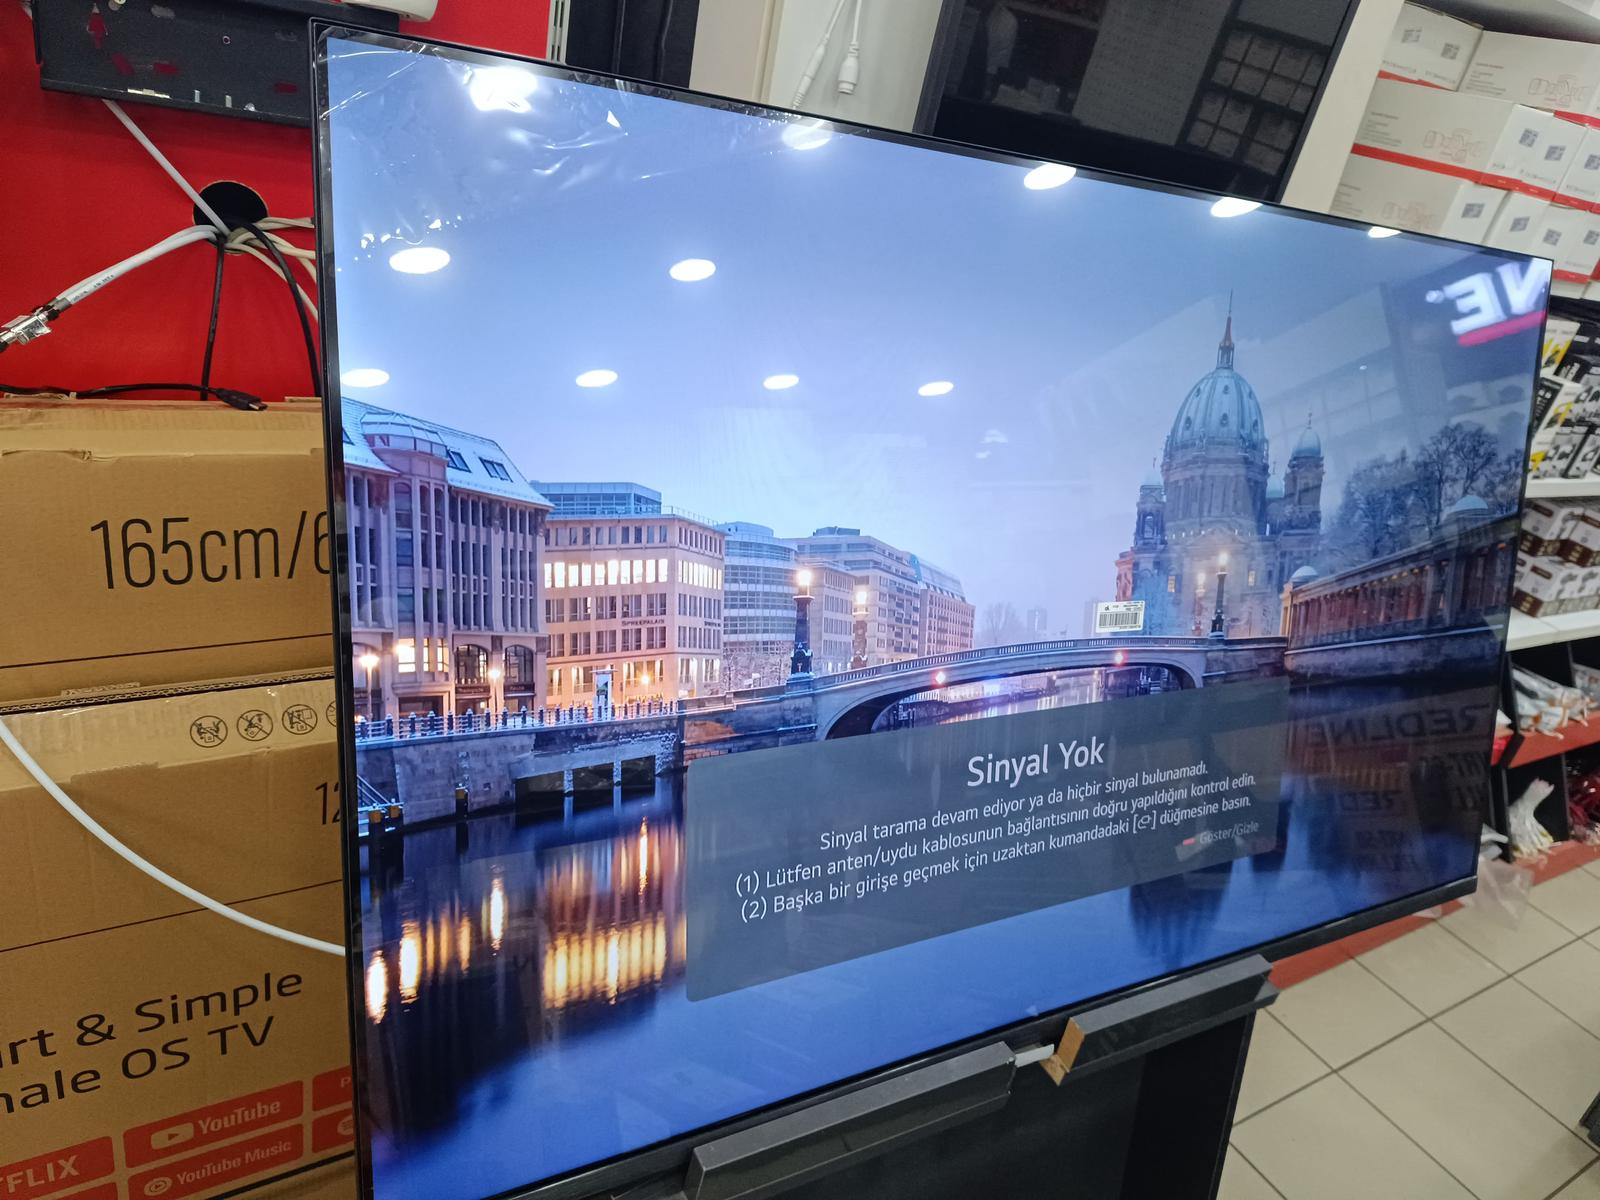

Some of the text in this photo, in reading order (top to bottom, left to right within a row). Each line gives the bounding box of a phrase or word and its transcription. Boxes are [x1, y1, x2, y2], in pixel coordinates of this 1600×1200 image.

[967, 736, 1105, 788] Sinyal Yok
[735, 772, 1257, 898] (1) Lütfen anten/uydu kablosunun bağlantısının doğru yapıldığını kontrol edin.
[820, 760, 1209, 850] Sinyal tarama devam ediyor ya da hiçbir sinyal bulunamadı.
[741, 895, 767, 923] (2)
[773, 888, 823, 913] Başka
[829, 876, 851, 901] bir
[856, 872, 899, 899] girişe
[903, 856, 960, 887] geçmek
[964, 851, 988, 872] için
[993, 840, 1045, 863] uzaktan
[1049, 818, 1129, 850] kumandadaki
[1160, 802, 1219, 825] düğmesine
[1222, 796, 1252, 812] basın.
[0, 972, 303, 1069] rt & Simple
[121, 1037, 190, 1080] OS
[207, 1015, 275, 1056] TV
[198, 1101, 281, 1135] YouTube
[0, 1154, 80, 1194] FLIX
[176, 1139, 292, 1185] YouTube Music
